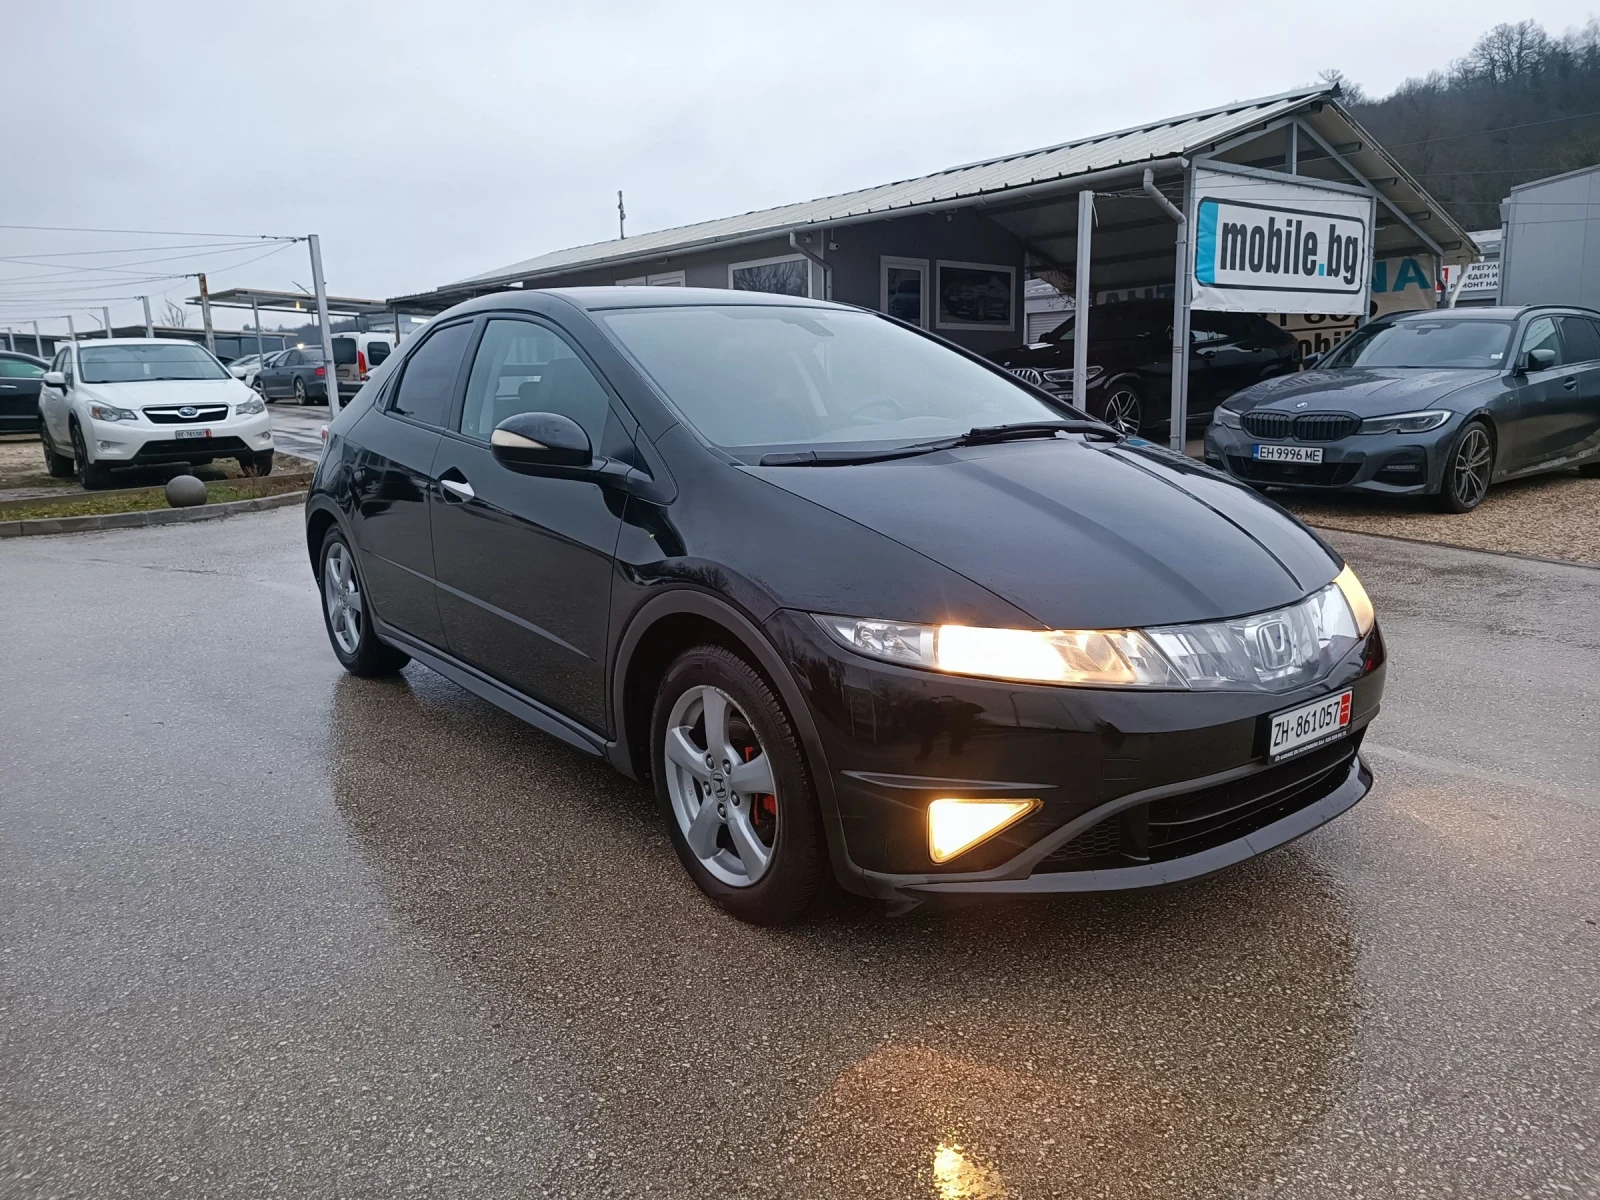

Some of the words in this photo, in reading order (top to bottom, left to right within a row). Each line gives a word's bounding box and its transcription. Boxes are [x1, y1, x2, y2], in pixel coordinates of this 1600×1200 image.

[1220, 216, 1359, 285] mobile.bg
[1260, 446, 1274, 459] EH
[1276, 448, 1303, 460] 9996
[1305, 449, 1321, 461] ME
